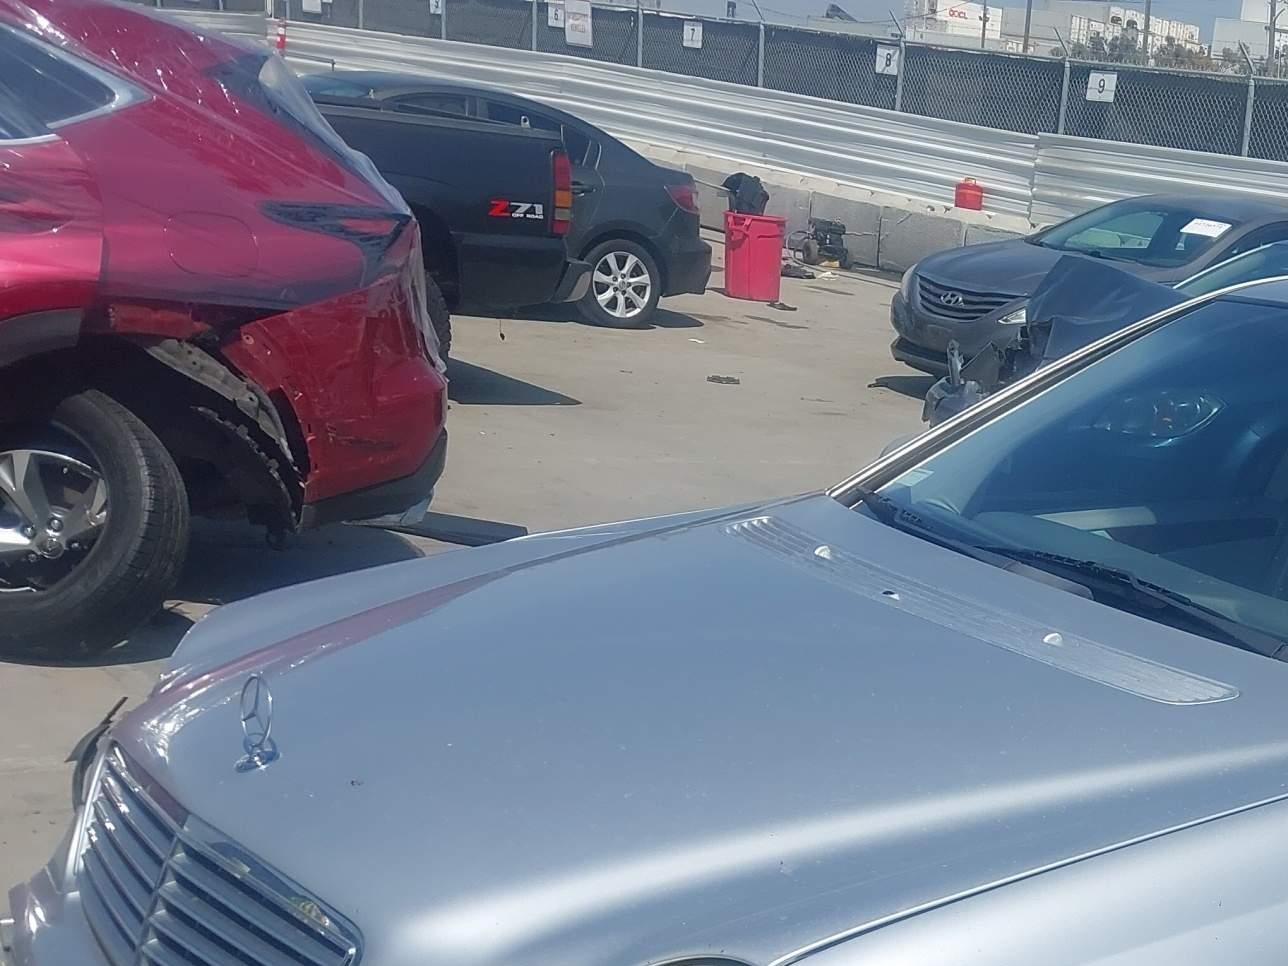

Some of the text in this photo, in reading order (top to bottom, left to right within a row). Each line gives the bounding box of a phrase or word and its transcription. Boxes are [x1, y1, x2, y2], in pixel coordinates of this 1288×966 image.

[553, 9, 559, 21] 6
[690, 27, 696, 41] 7
[885, 53, 892, 67] 8
[1097, 78, 1106, 94] 9
[488, 200, 543, 217] Z71
